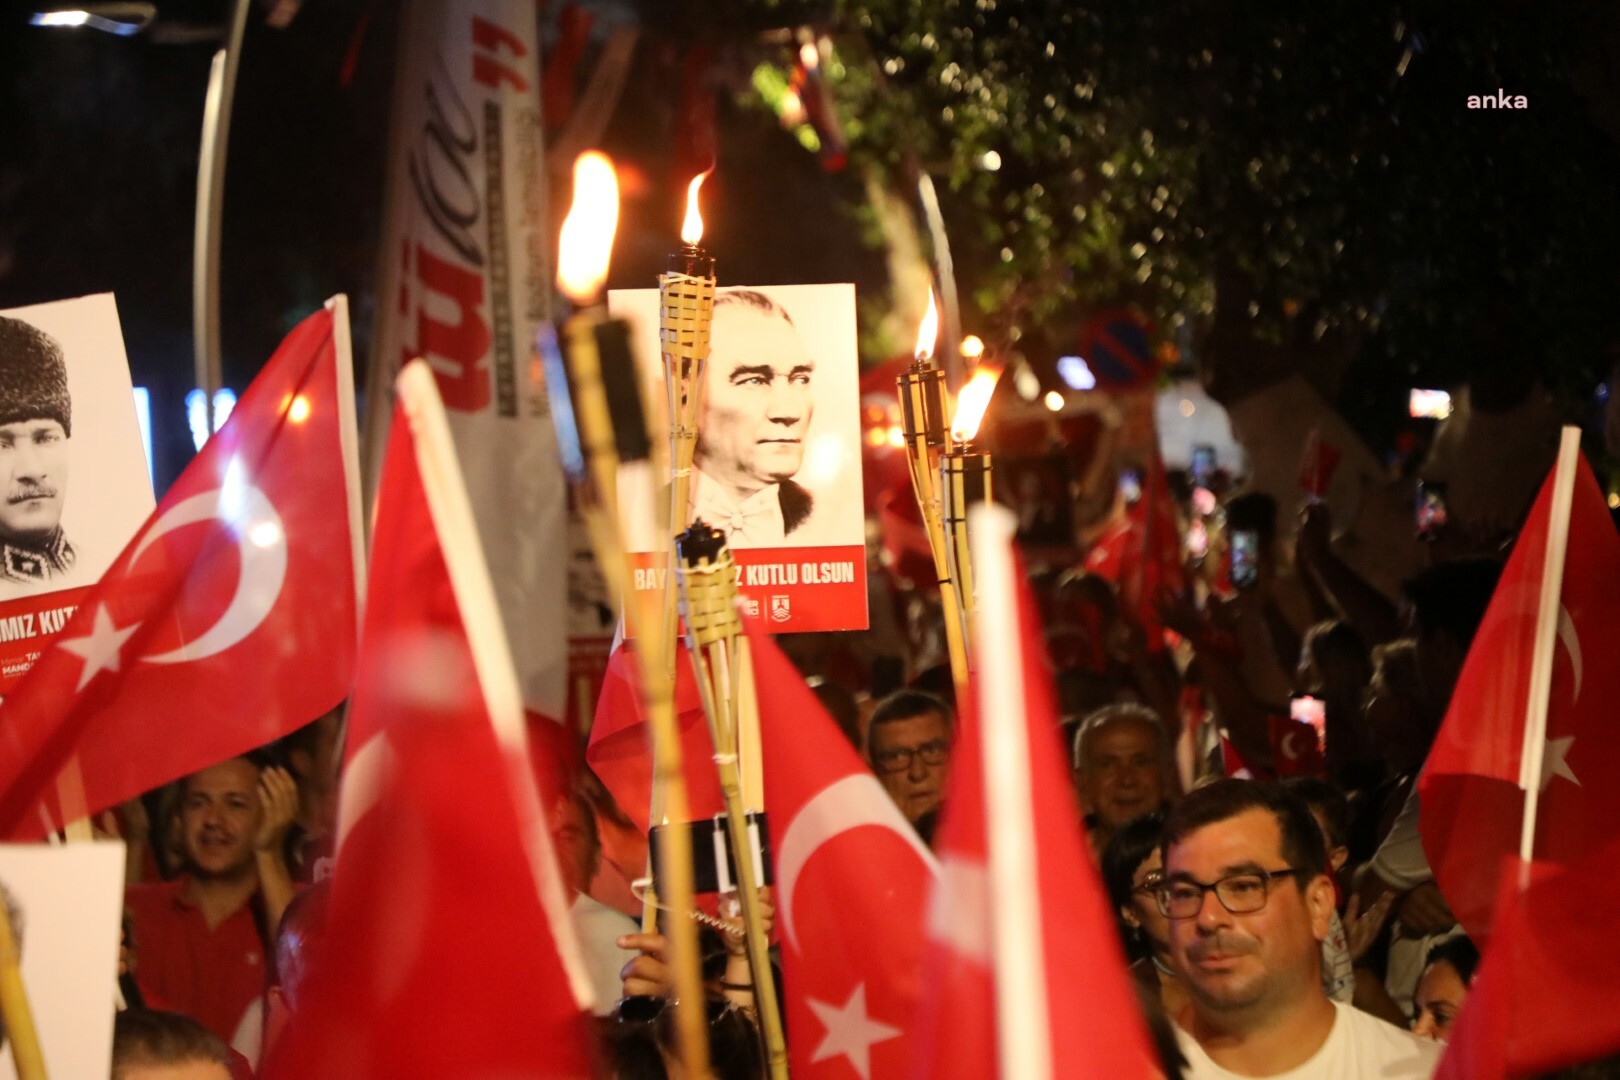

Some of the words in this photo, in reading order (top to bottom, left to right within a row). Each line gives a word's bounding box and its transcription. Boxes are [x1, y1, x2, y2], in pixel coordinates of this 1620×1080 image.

[746, 563, 798, 586] KUTLU
[801, 562, 854, 584] OLSUN
[0, 614, 37, 642] MIZ
[38, 605, 79, 635] KUT
